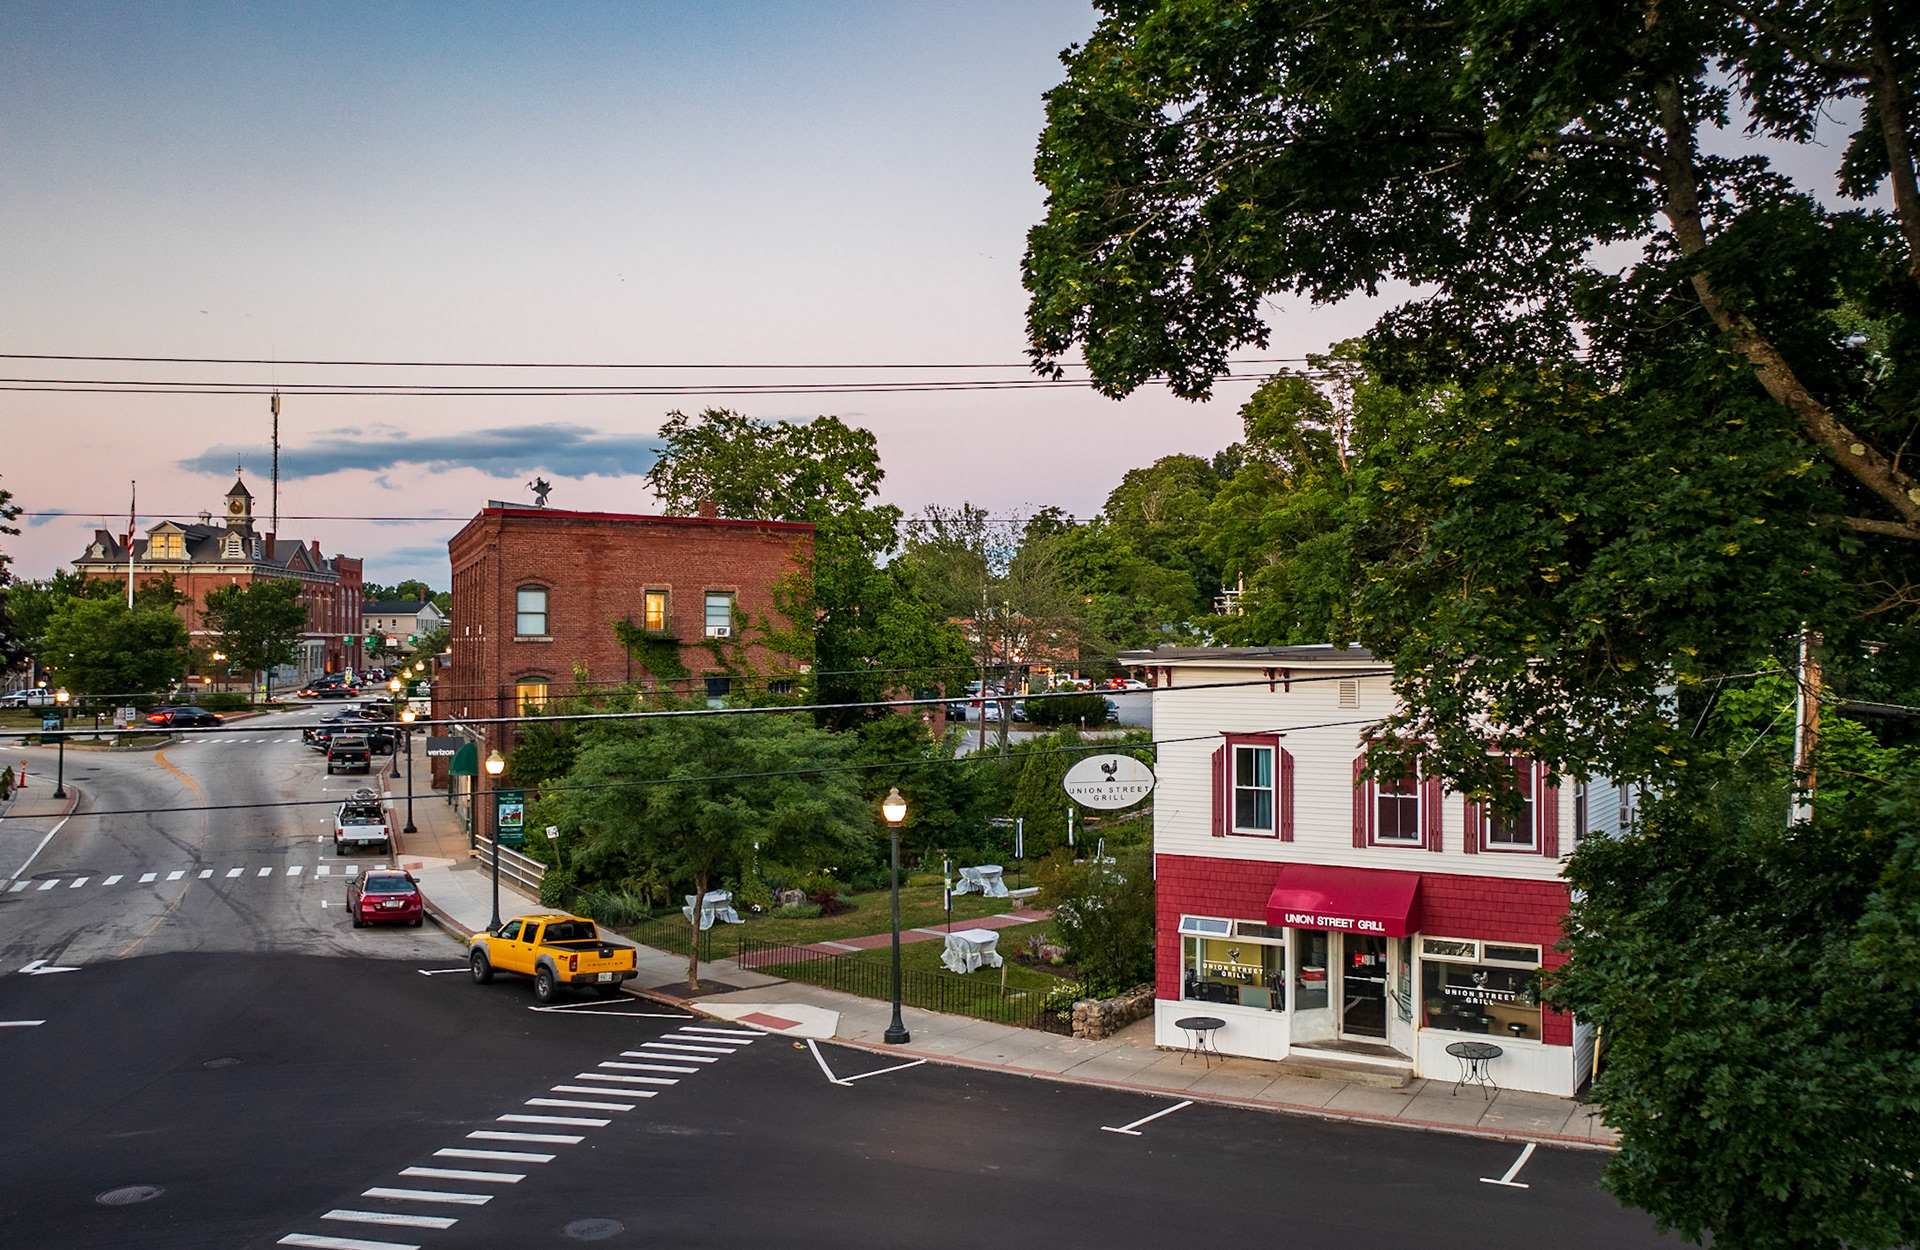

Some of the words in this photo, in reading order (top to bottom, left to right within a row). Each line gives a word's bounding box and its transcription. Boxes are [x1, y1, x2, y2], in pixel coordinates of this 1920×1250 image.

[427, 748, 455, 756] verizon
[1285, 913, 1314, 925] UNION
[1317, 916, 1355, 928] STREET
[1358, 920, 1385, 931] GRILL
[1202, 963, 1229, 971] UNION
[1231, 966, 1264, 975] STREET
[1221, 970, 1246, 979] GRILL
[1445, 988, 1475, 997] UNION
[1478, 991, 1515, 1001] STREET
[1466, 996, 1494, 1006] GRILL
